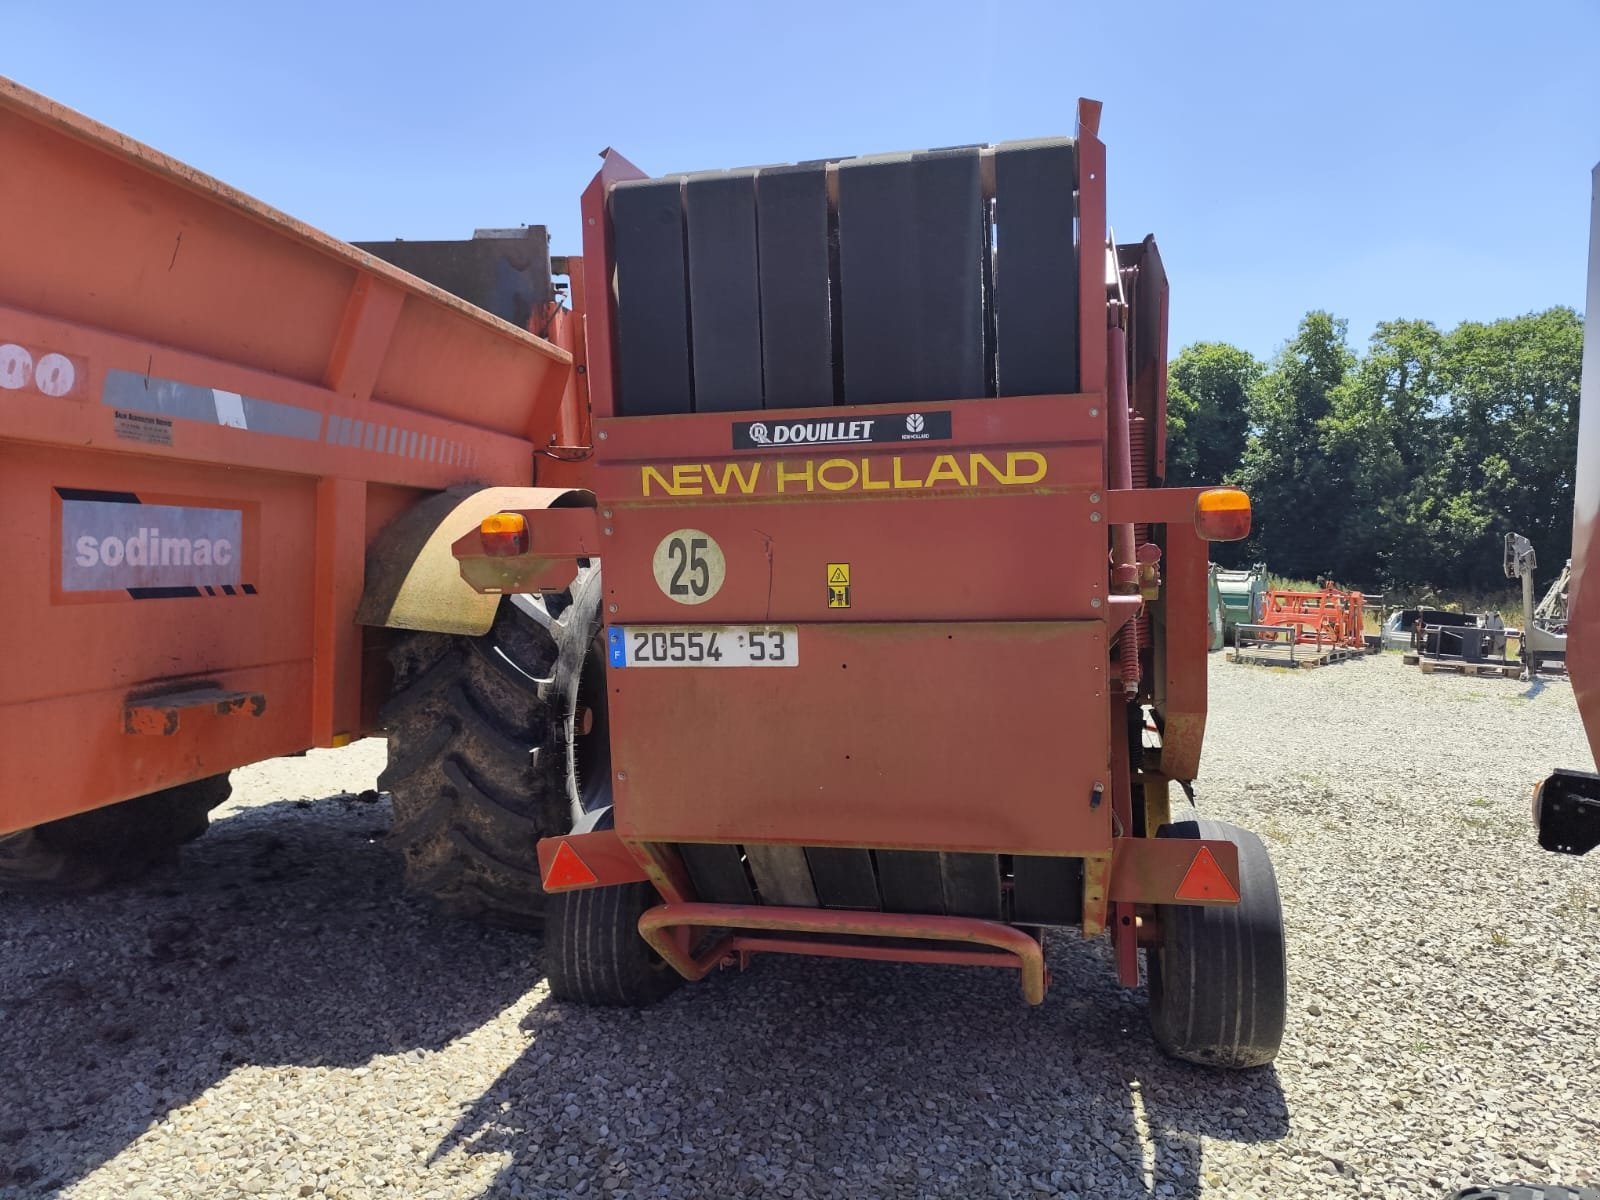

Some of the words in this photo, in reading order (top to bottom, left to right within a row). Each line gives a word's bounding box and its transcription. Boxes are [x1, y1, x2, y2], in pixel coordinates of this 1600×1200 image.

[773, 420, 875, 443] DOUILLET
[641, 462, 762, 497] NEW
[777, 451, 1048, 493] HOLLAND
[75, 527, 232, 567] sodimac
[668, 537, 710, 597] 25
[614, 651, 620, 660] F
[633, 632, 722, 661] 20554
[748, 631, 785, 661] 53
